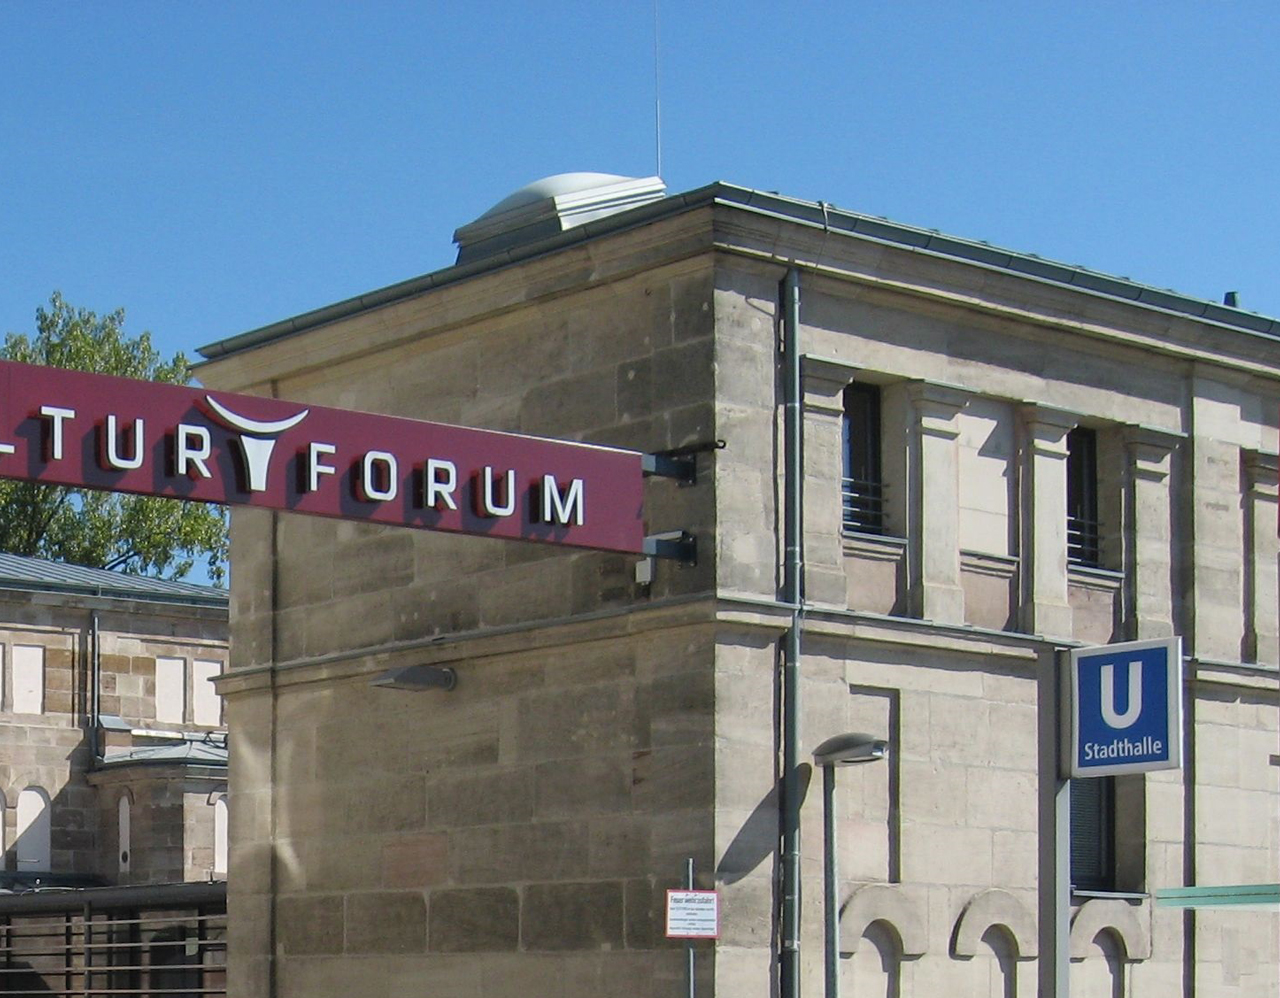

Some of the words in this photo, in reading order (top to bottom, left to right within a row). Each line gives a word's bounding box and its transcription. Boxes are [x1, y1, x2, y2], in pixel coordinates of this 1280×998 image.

[307, 441, 585, 527] FORUM
[1100, 661, 1143, 729] U
[1084, 736, 1162, 760] Stadthalle
